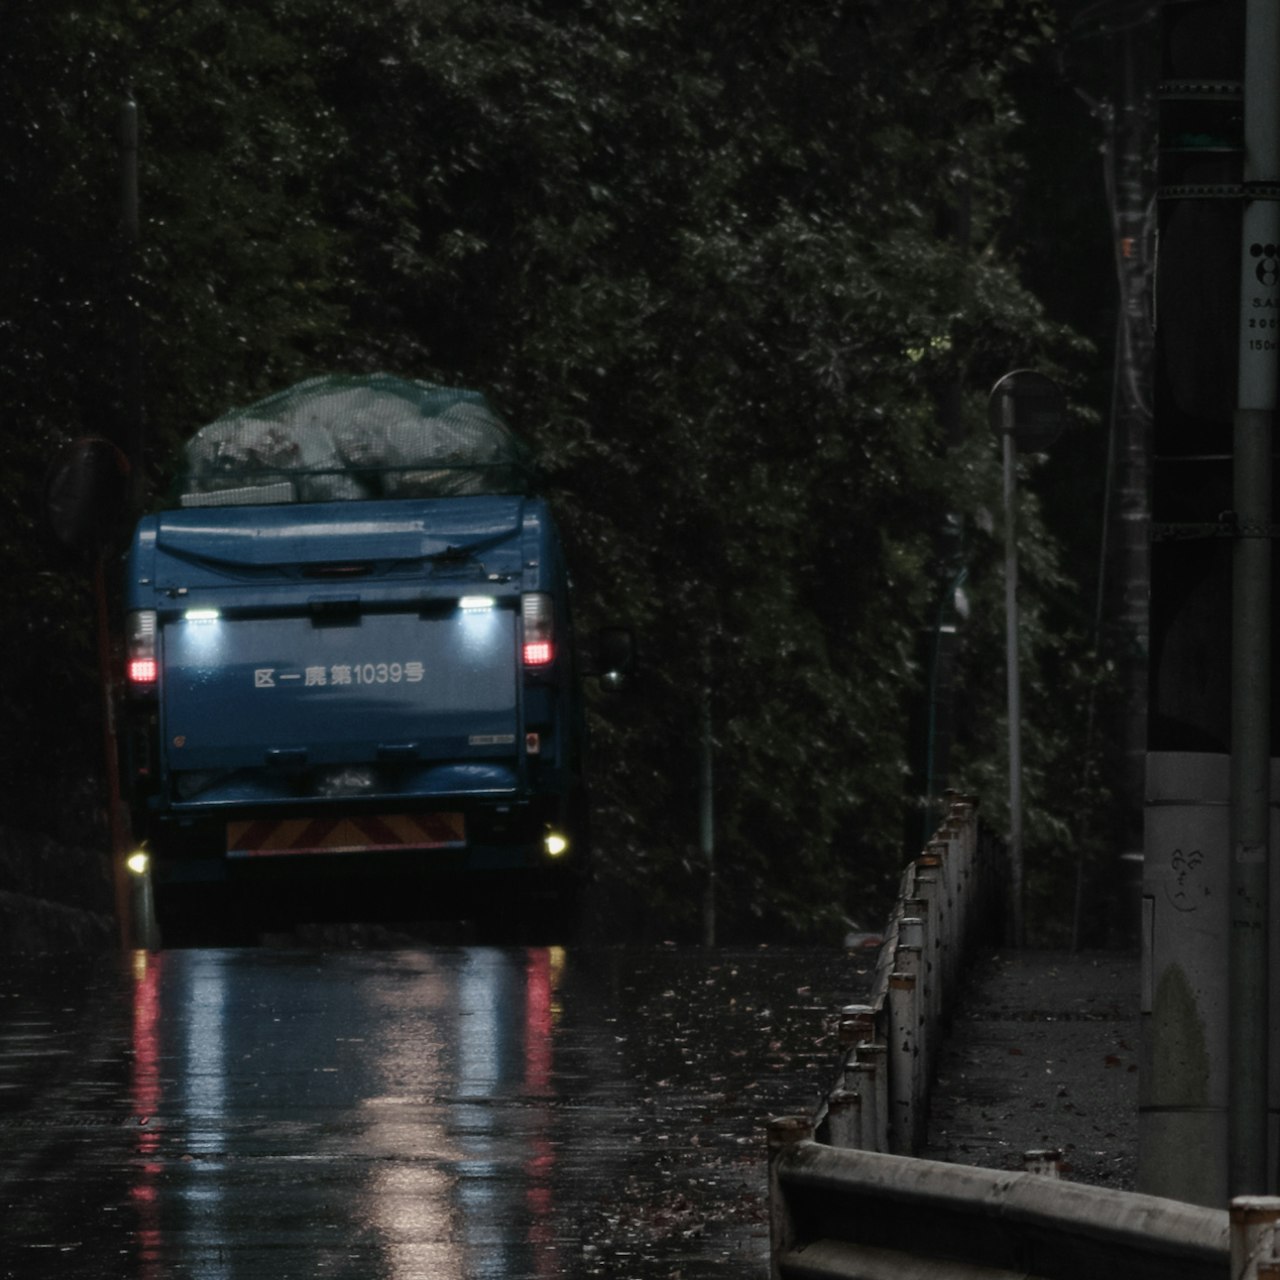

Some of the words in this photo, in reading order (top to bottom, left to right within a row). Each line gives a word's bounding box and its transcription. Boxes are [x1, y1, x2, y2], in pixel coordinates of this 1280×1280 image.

[254, 661, 426, 688] 区一廃第1039号
